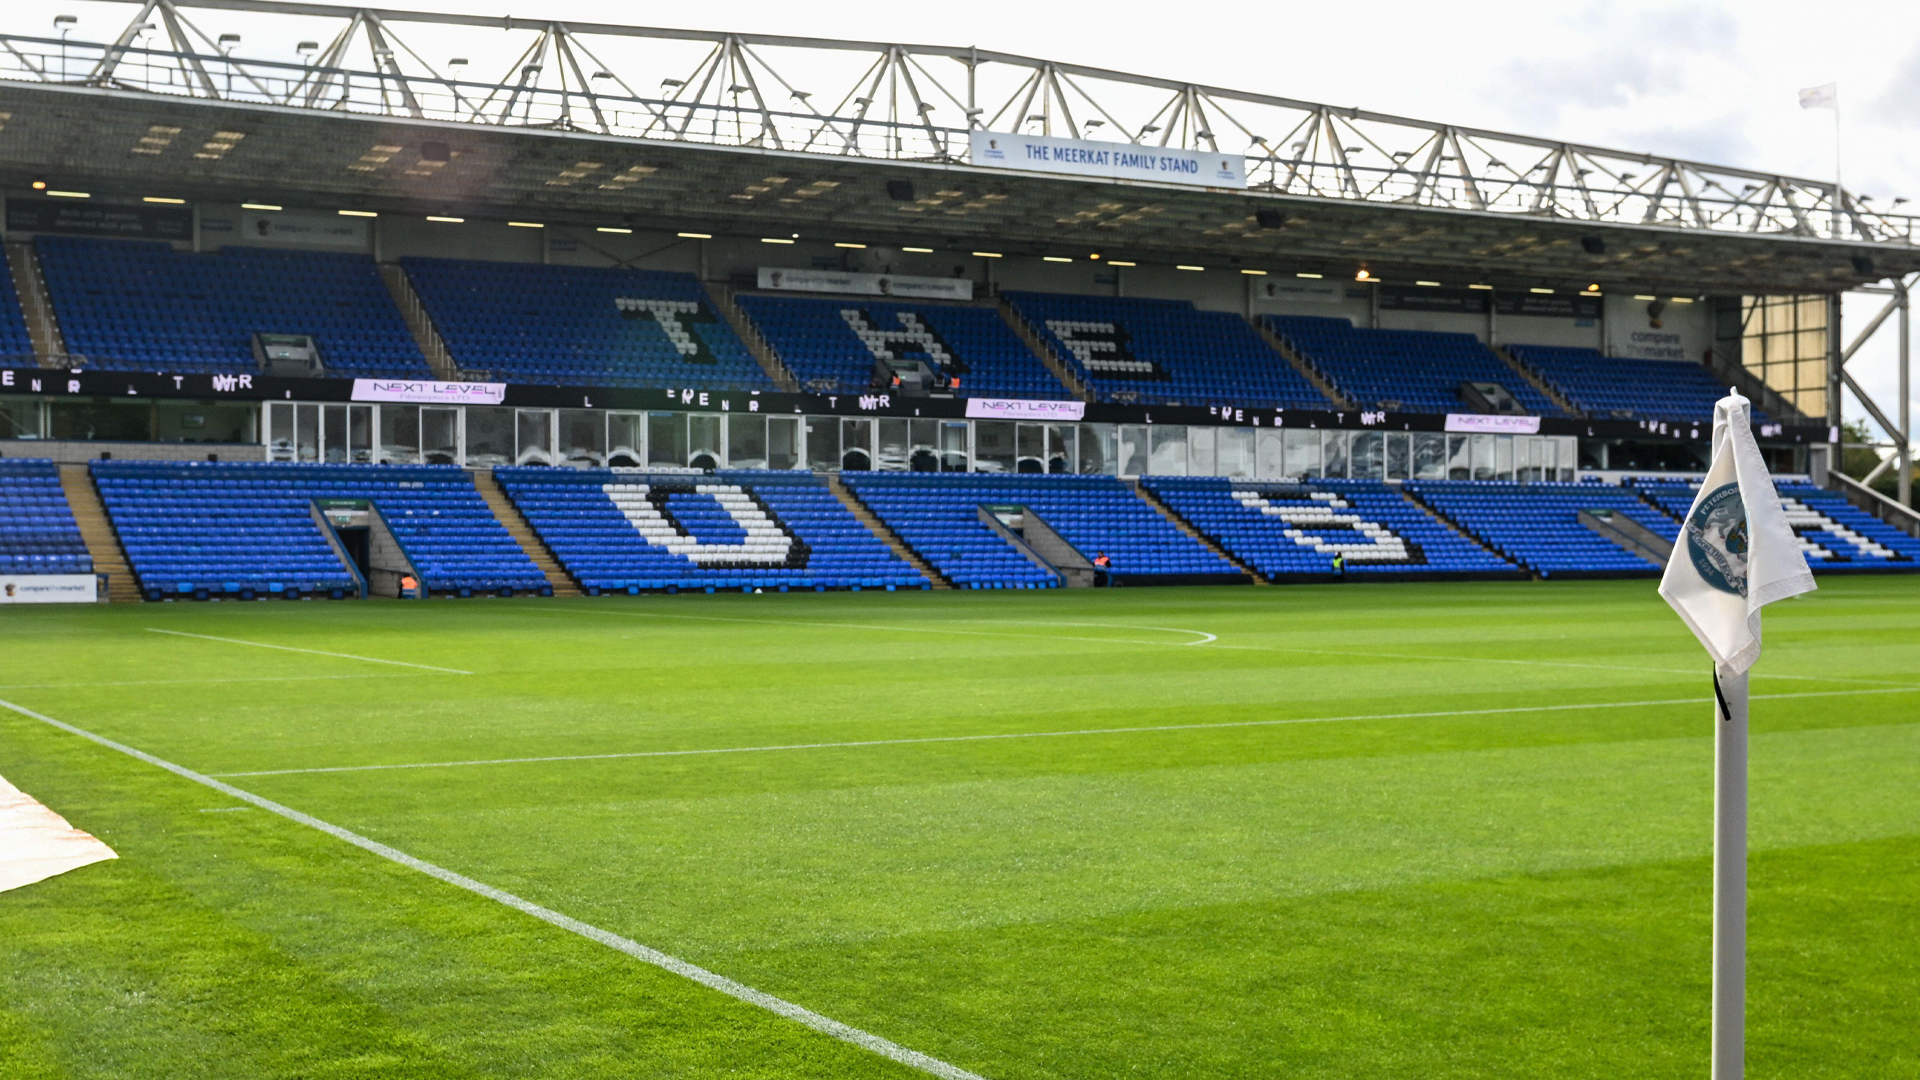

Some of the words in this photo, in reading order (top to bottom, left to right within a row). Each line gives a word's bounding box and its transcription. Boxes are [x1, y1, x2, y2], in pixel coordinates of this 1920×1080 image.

[1025, 144, 1050, 161] THE
[1053, 147, 1110, 166] MEERKAT
[1113, 152, 1157, 170] FAMILY
[1160, 157, 1199, 174] STAND
[373, 383, 427, 393] NEXT
[433, 384, 496, 395] LEVEL
[982, 401, 1024, 410] NEXT
[1028, 402, 1077, 413] LEVEL
[1699, 558, 1715, 577] 1934
